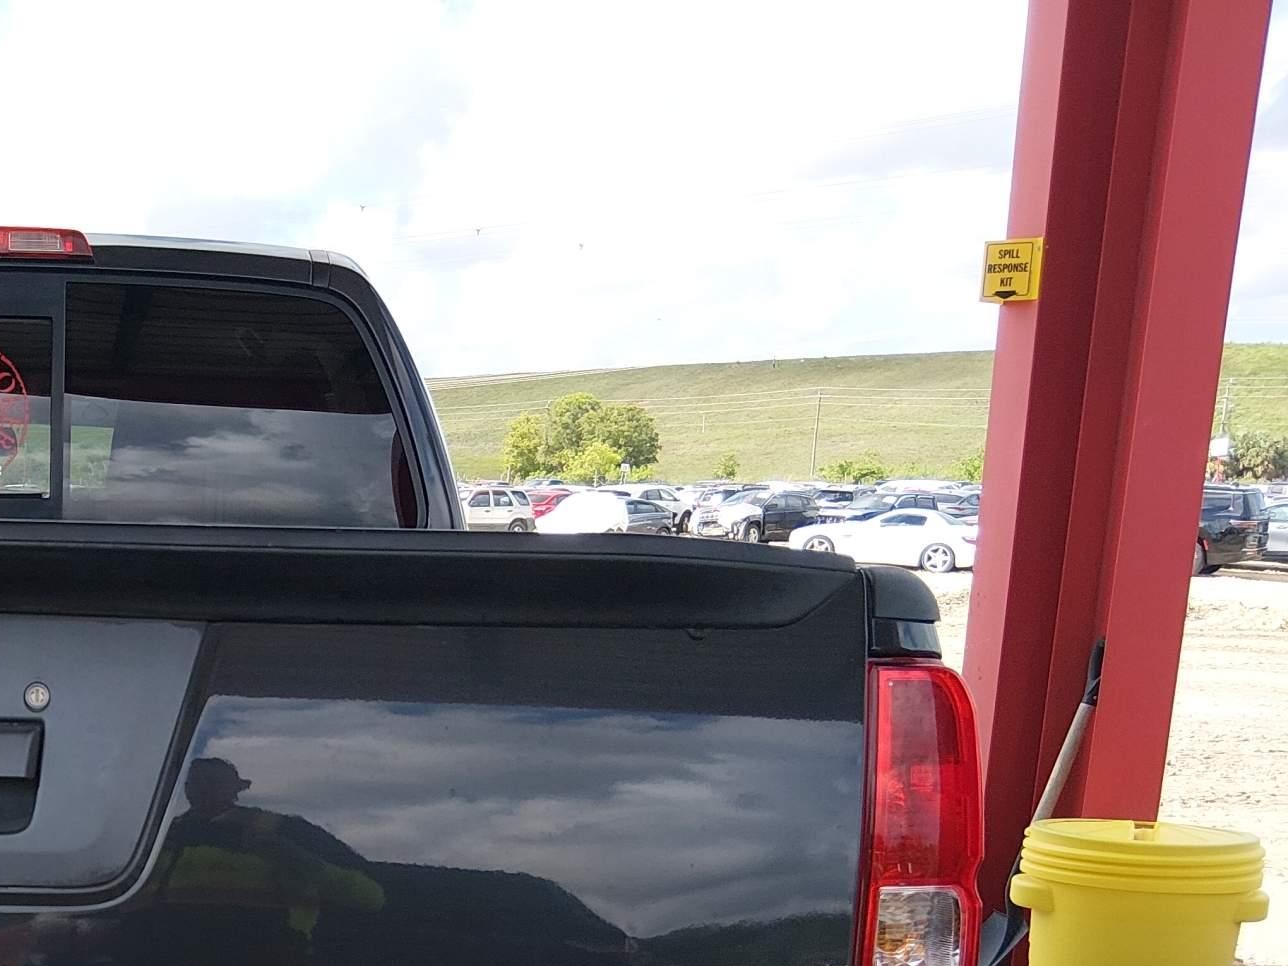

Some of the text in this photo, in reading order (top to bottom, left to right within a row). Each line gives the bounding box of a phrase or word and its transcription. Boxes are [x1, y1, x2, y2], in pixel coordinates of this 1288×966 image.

[998, 248, 1021, 259] SPILL
[987, 262, 1029, 273] RESPONSE
[999, 277, 1013, 287] KIT
